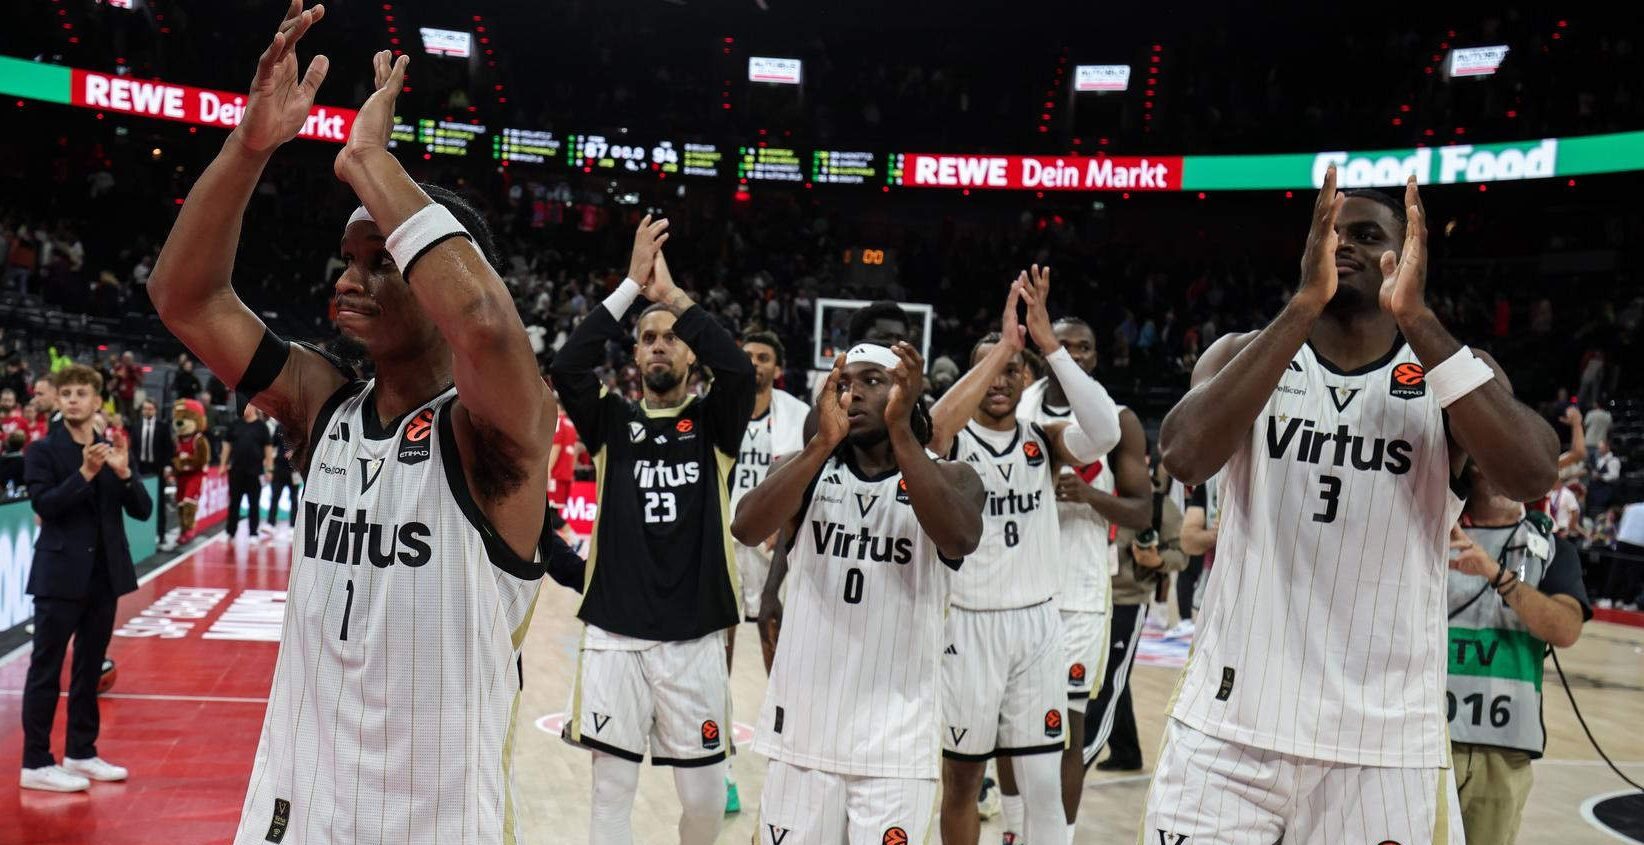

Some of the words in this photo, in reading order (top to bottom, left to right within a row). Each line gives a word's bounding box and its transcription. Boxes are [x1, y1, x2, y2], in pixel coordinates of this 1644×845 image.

[85, 74, 185, 118] REWE
[299, 108, 345, 140] rkt
[915, 156, 1008, 186] REWE
[1022, 158, 1078, 188] Dein
[1085, 158, 1167, 188] Markt
[1312, 147, 1431, 188] Good
[1439, 138, 1557, 183] Food
[399, 450, 428, 458] ETIHAD
[742, 448, 770, 465] rtu
[1267, 415, 1412, 475] Virtus
[740, 469, 757, 487] 21
[562, 496, 597, 521] Ma
[645, 492, 676, 523] 23
[985, 489, 1041, 516] irtu
[1312, 475, 1342, 523] 3
[304, 501, 432, 568] Virtus
[812, 520, 912, 565] Virtus
[1004, 521, 1019, 547] 8
[843, 568, 864, 604] 0
[339, 579, 354, 641] 1
[1452, 639, 1498, 666] TV
